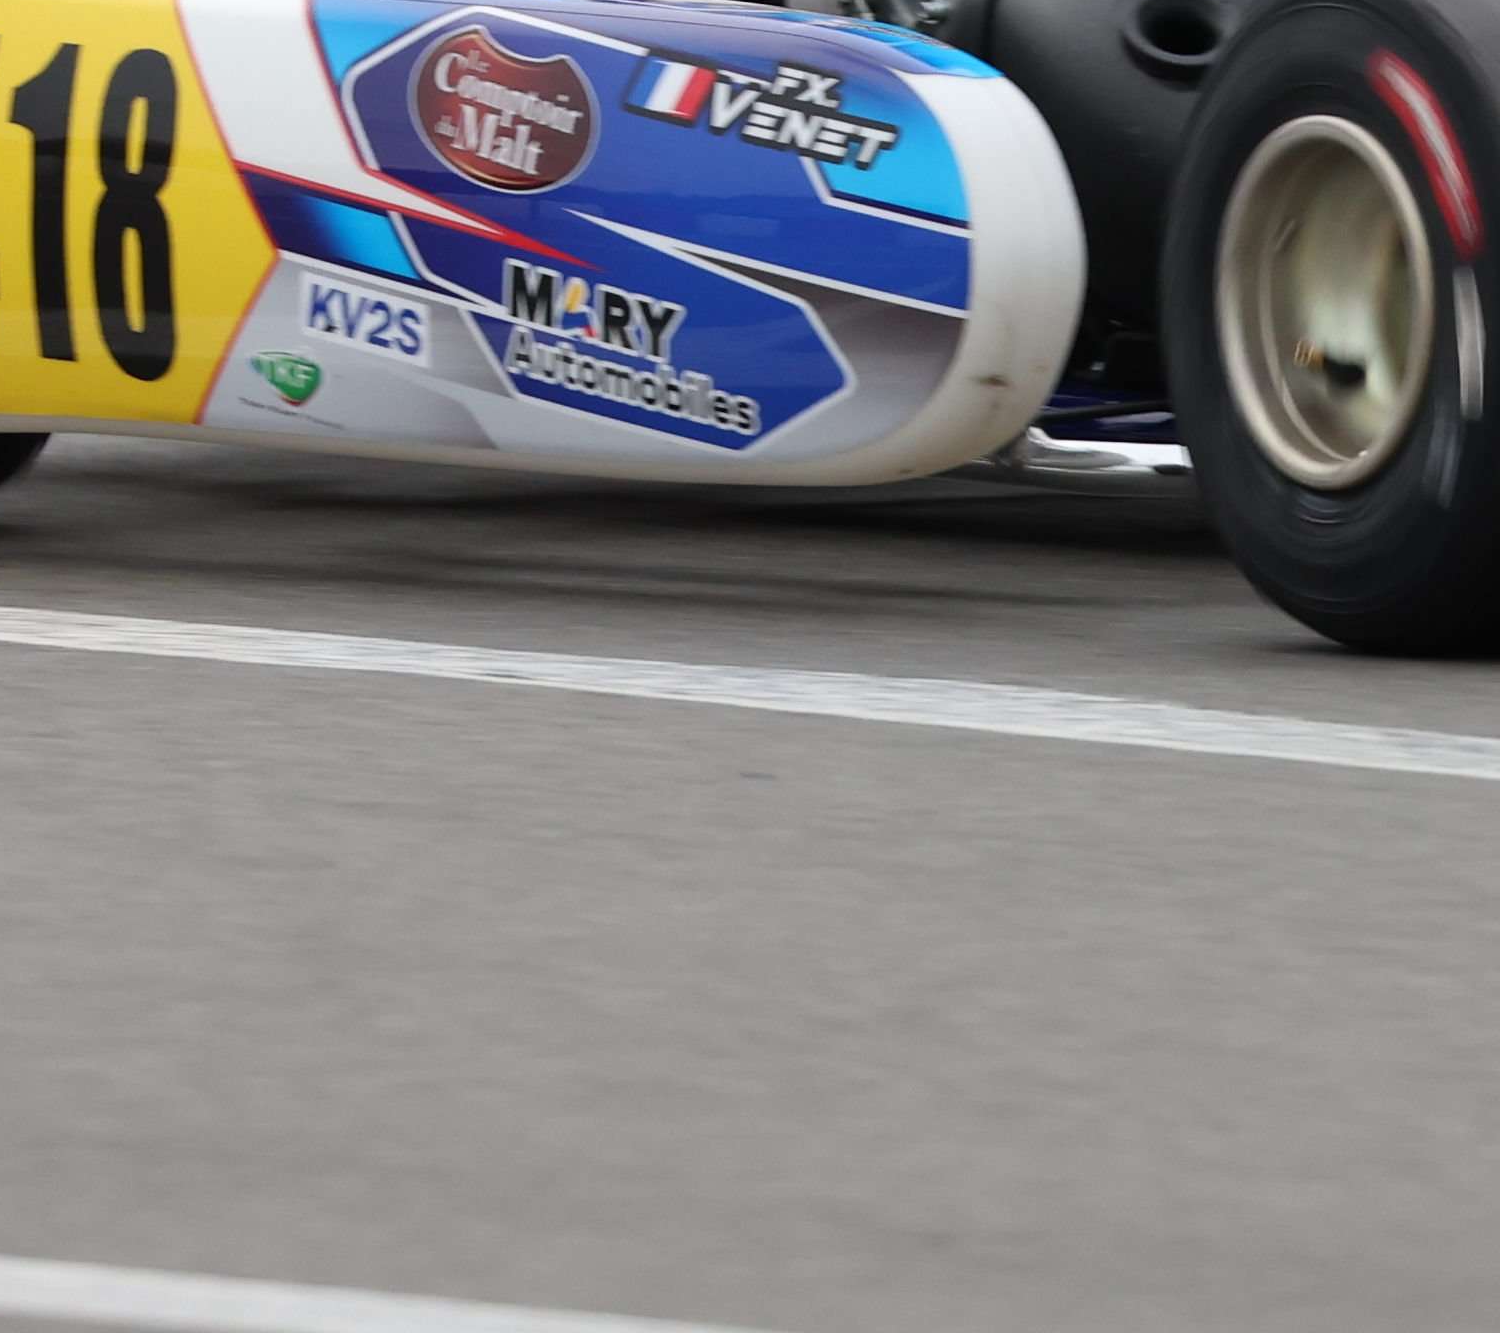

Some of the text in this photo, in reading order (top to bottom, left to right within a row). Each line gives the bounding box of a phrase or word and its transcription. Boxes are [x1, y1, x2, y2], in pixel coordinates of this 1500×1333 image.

[434, 52, 584, 135] Comptoir
[710, 82, 897, 163] VENET
[450, 103, 544, 176] Malt
[307, 283, 422, 356] KV2S
[503, 258, 687, 366] MARY
[505, 327, 761, 434] Automobiles
